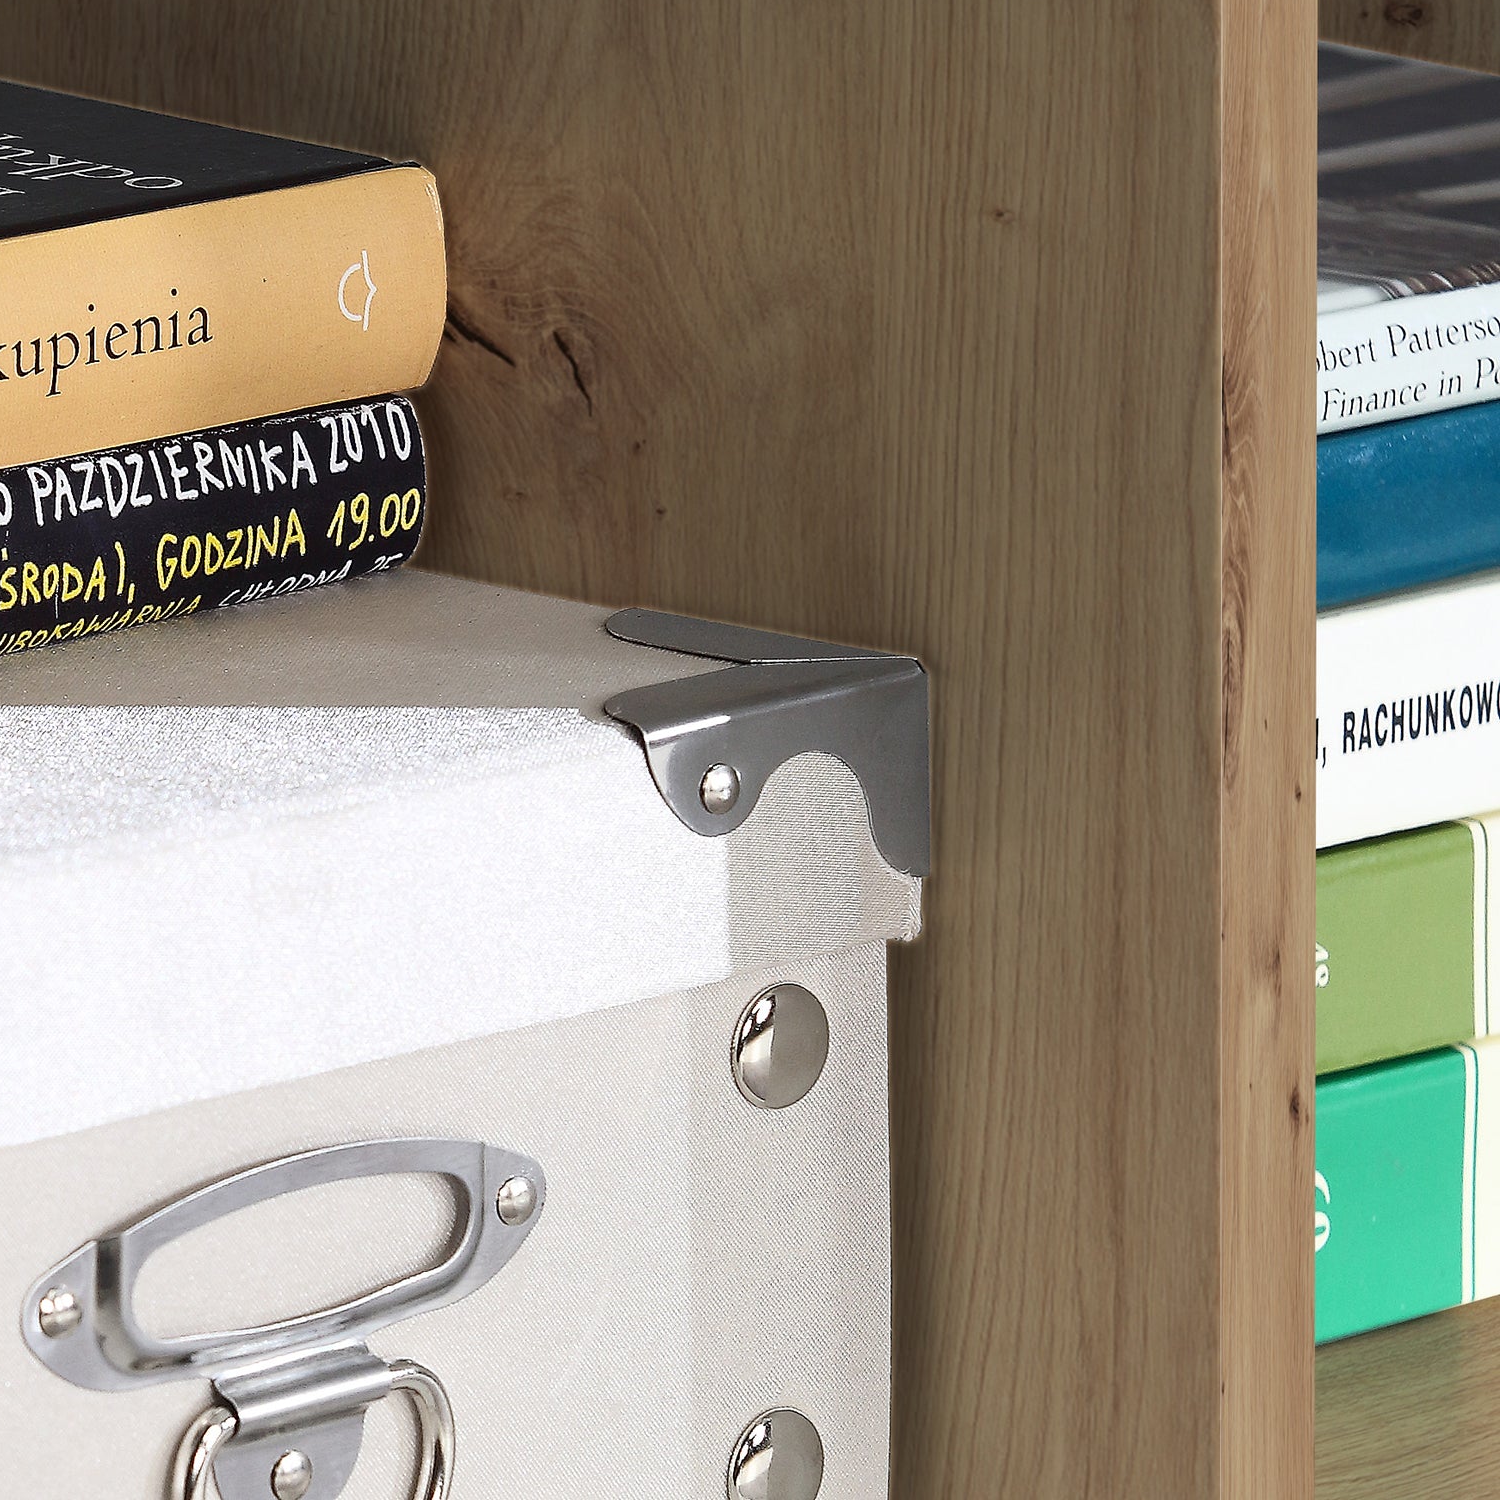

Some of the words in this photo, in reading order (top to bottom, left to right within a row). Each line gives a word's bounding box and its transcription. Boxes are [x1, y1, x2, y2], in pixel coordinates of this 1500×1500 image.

[1316, 338, 1376, 373] bert
[1322, 382, 1427, 422] Finance
[1439, 371, 1462, 398] in
[319, 399, 411, 473] 2010
[156, 507, 306, 590] GODZINA
[327, 488, 421, 552] 19.00
[1343, 680, 1500, 755] RACHUNKOW
